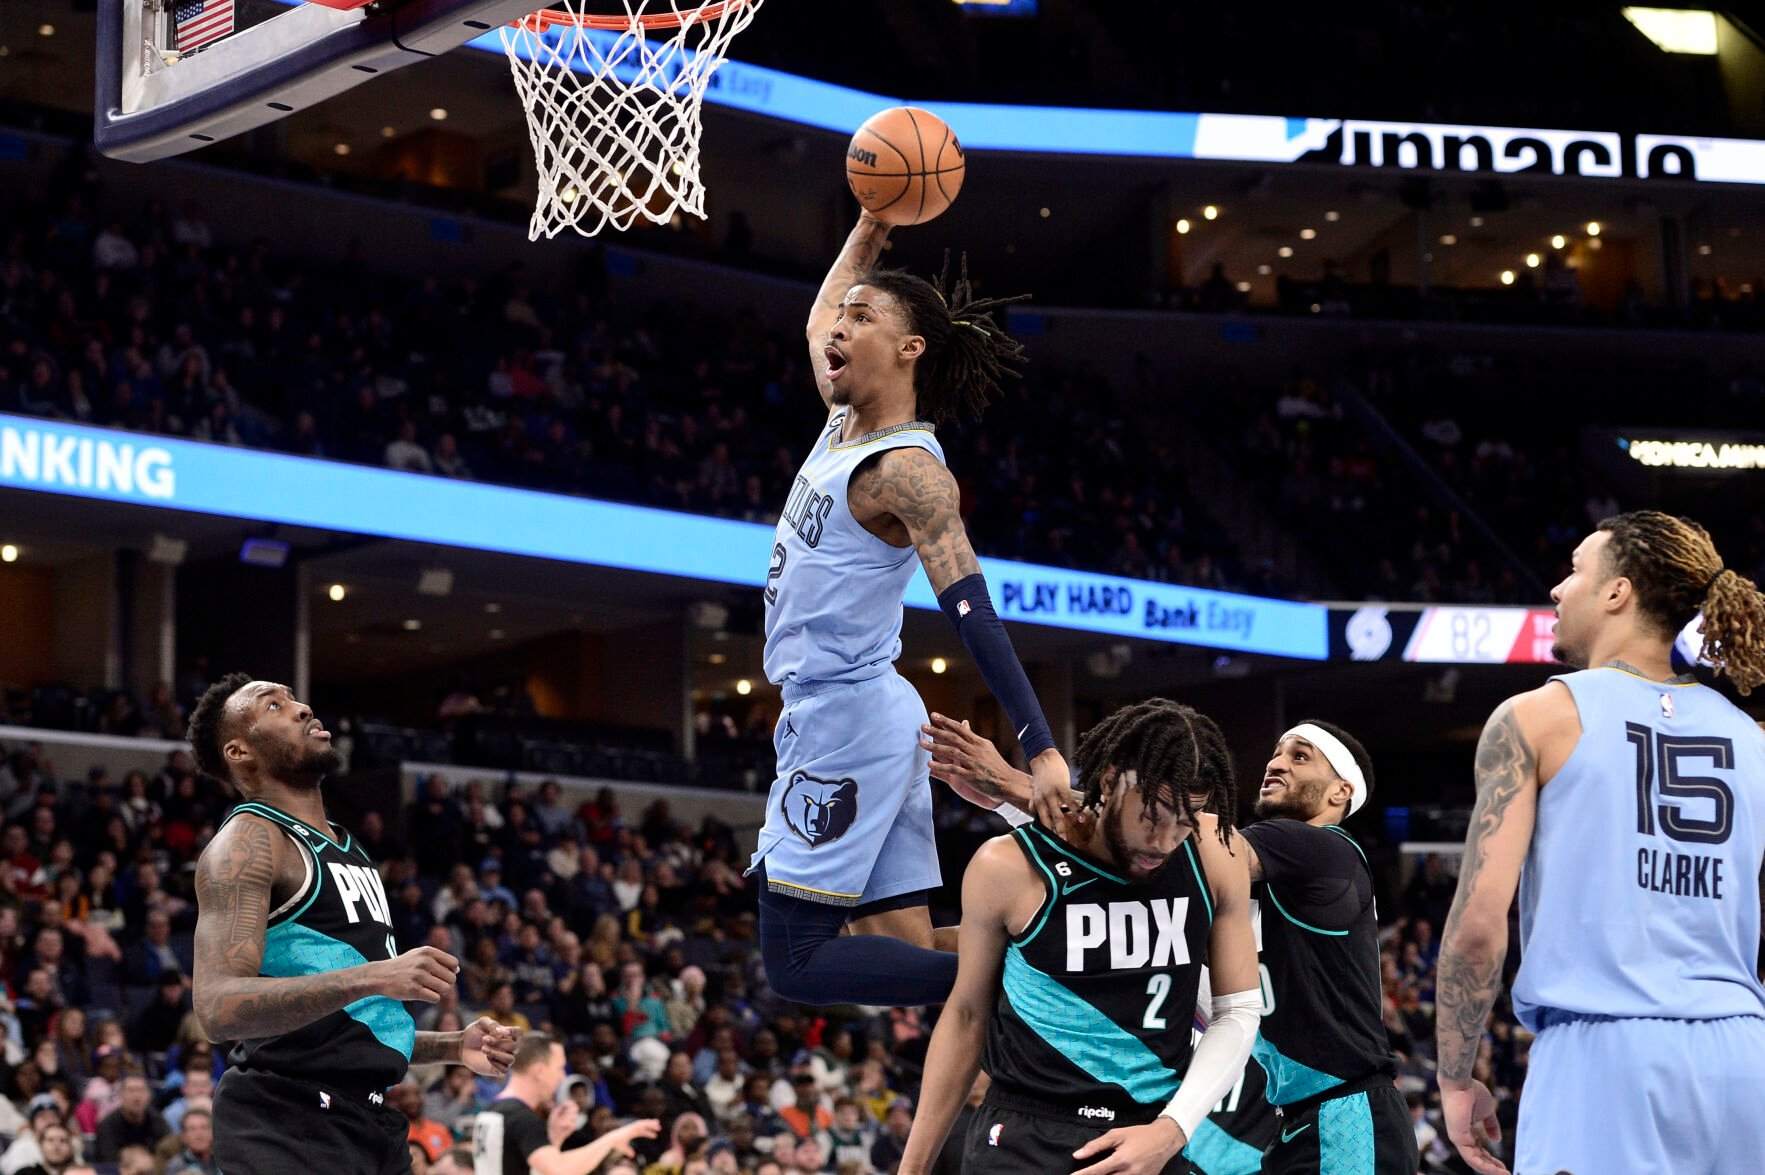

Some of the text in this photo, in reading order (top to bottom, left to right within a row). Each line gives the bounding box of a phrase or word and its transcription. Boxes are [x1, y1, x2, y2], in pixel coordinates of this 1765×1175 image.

[1002, 582, 1256, 640] PLAY HARD Bank Easy
[1451, 611, 1492, 658] 82
[1625, 721, 1735, 845] 15
[1055, 861, 1072, 877] 6
[1637, 847, 1723, 900] CLARKE
[1066, 896, 1191, 972] PDX
[1142, 973, 1172, 1030] 2
[1078, 1105, 1116, 1121] ripcity
